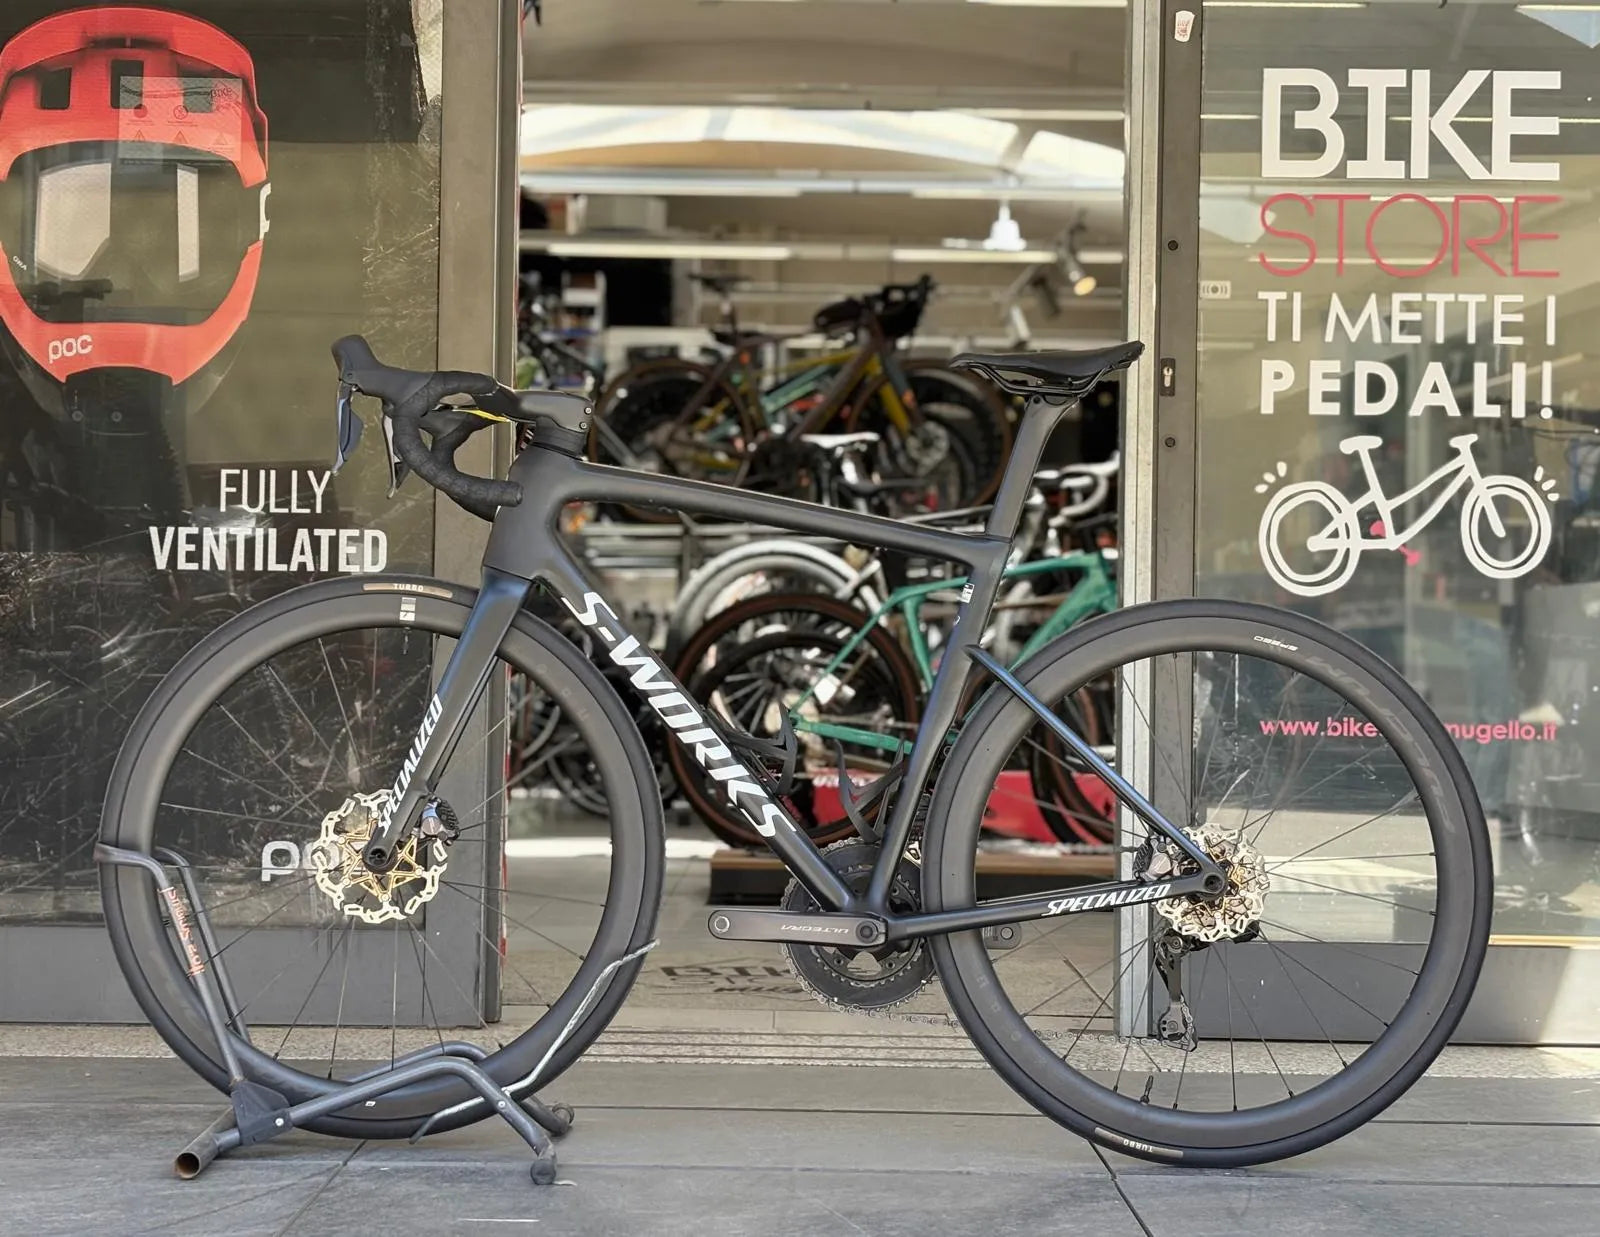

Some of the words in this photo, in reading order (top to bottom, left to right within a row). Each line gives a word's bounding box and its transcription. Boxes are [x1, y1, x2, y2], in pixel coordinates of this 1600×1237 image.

[1261, 68, 1562, 181] BIKE
[1259, 193, 1563, 278] STORE
[1257, 291, 1302, 342] TI
[1324, 292, 1524, 345] METTE
[1546, 295, 1556, 346] I
[48, 334, 93, 365] poc
[1260, 359, 1553, 420] PEDALI!
[219, 468, 331, 514] FULLY
[149, 526, 388, 572] VENTILATED
[393, 583, 424, 592] TURBO
[561, 591, 796, 838] S-WORKS
[378, 693, 443, 838] SPECIALIZED
[1041, 884, 1171, 916] SPECIALIZED
[1123, 1139, 1153, 1153] TURBO
